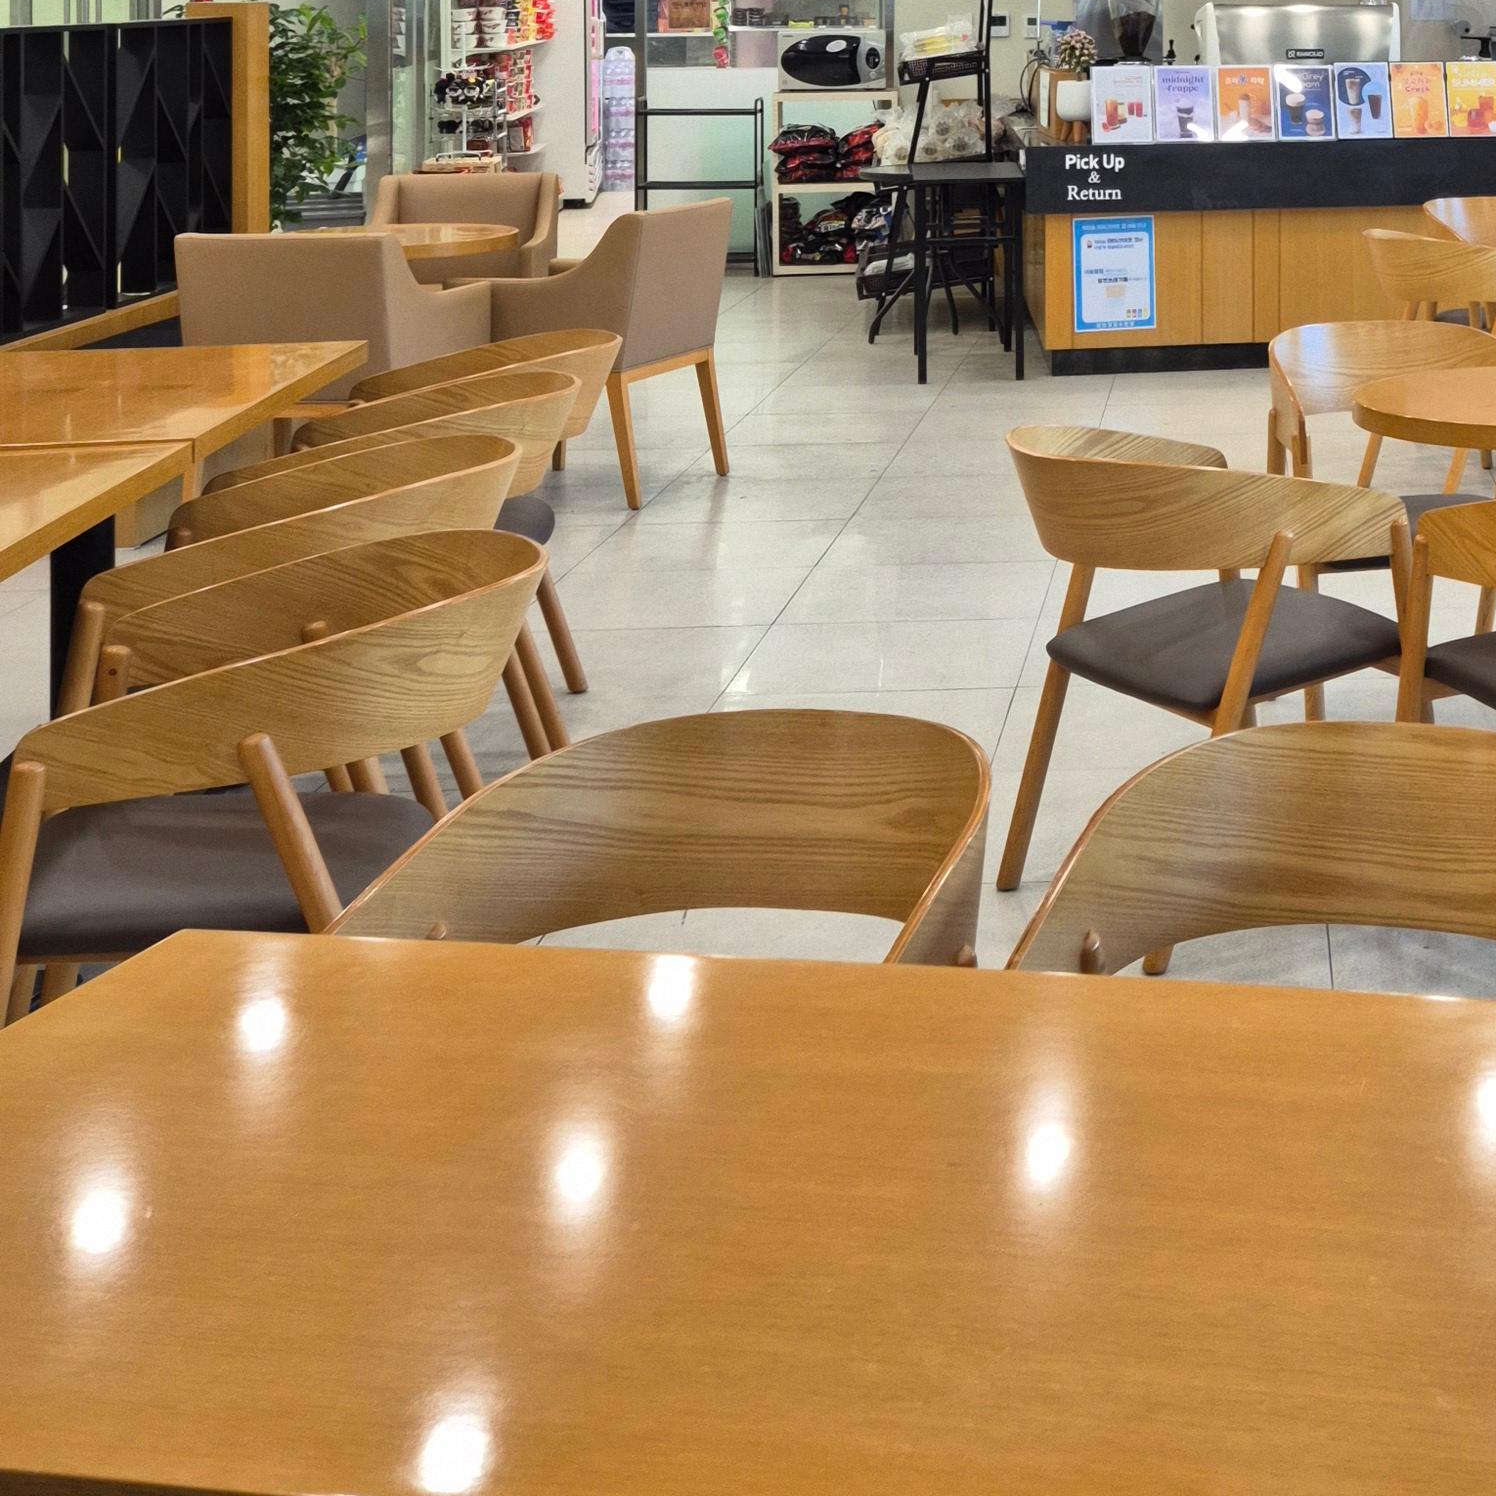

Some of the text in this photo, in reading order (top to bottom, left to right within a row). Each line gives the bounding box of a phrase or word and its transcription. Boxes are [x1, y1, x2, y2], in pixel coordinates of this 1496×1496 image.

[1162, 74, 1204, 85] midnight
[1065, 153, 1125, 173] Pick Up
[1088, 170, 1102, 184] &
[1067, 185, 1122, 201] Return
